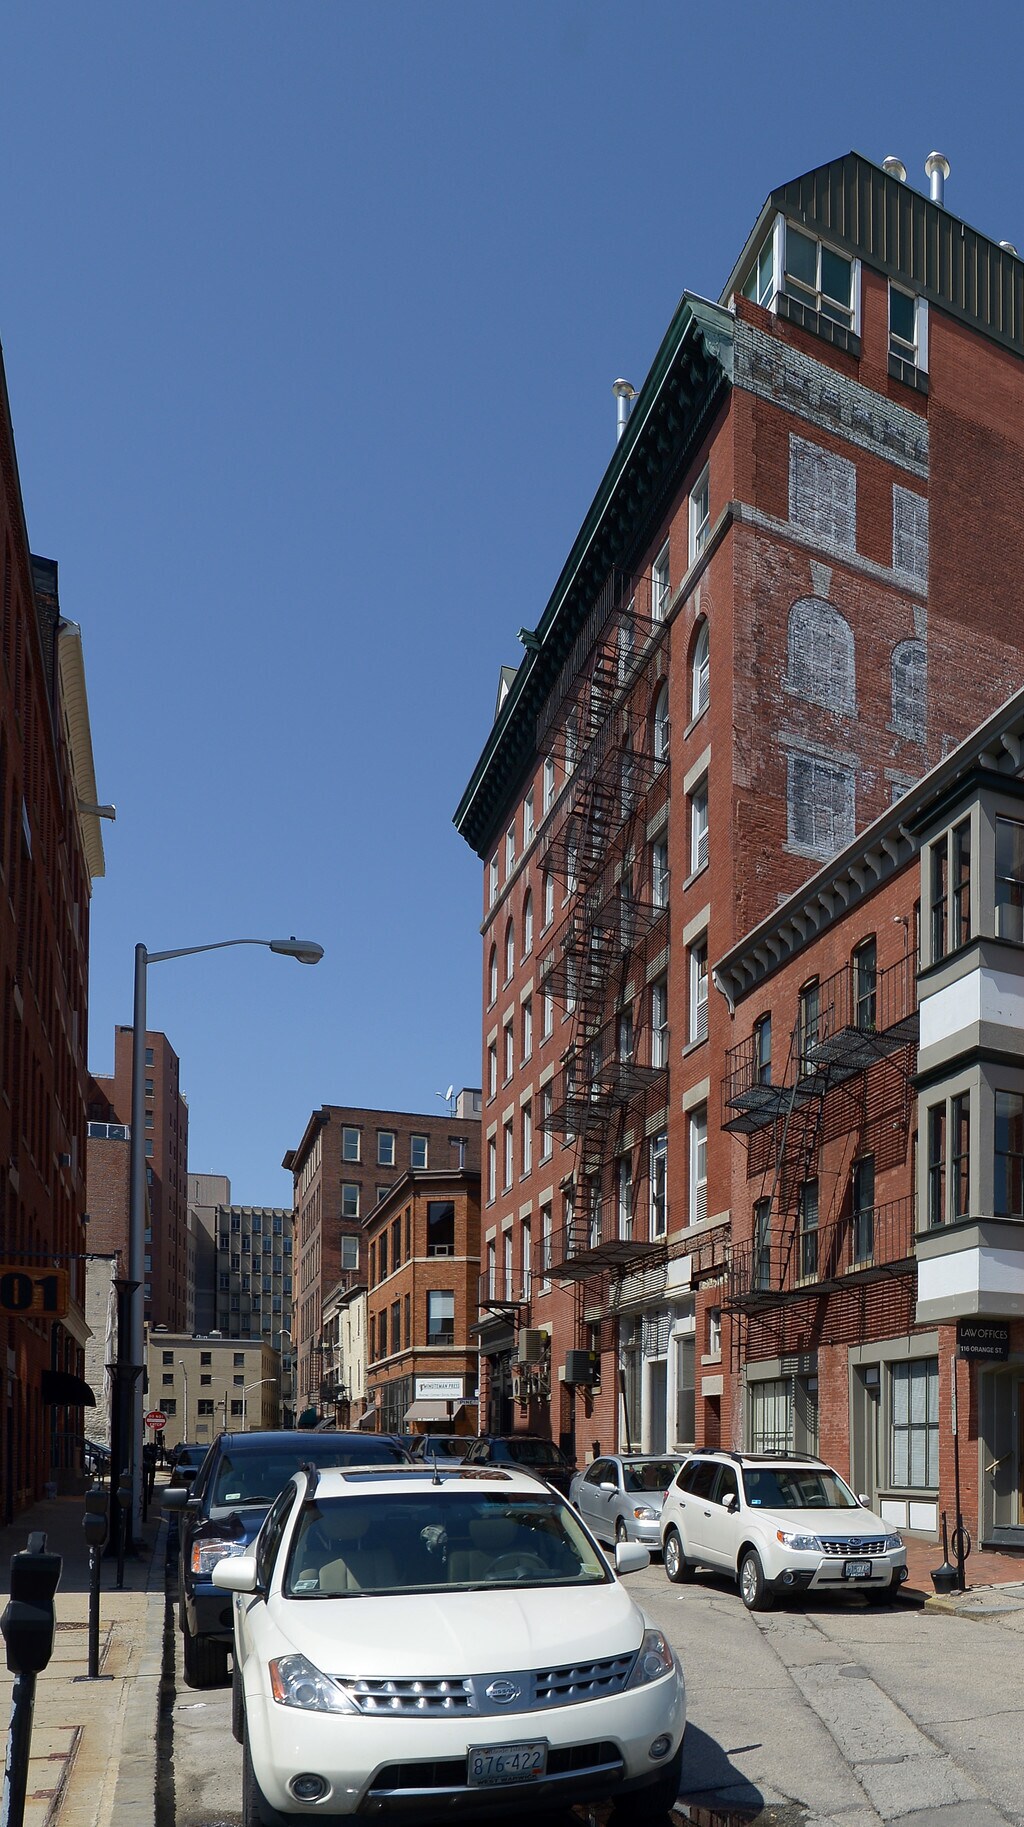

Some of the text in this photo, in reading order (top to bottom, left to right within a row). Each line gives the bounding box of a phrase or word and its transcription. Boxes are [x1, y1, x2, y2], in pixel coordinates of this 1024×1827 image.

[960, 1328, 1008, 1340] LAW OFFICES
[970, 1345, 994, 1354] ORANGE
[474, 1751, 541, 1775] 876-422
